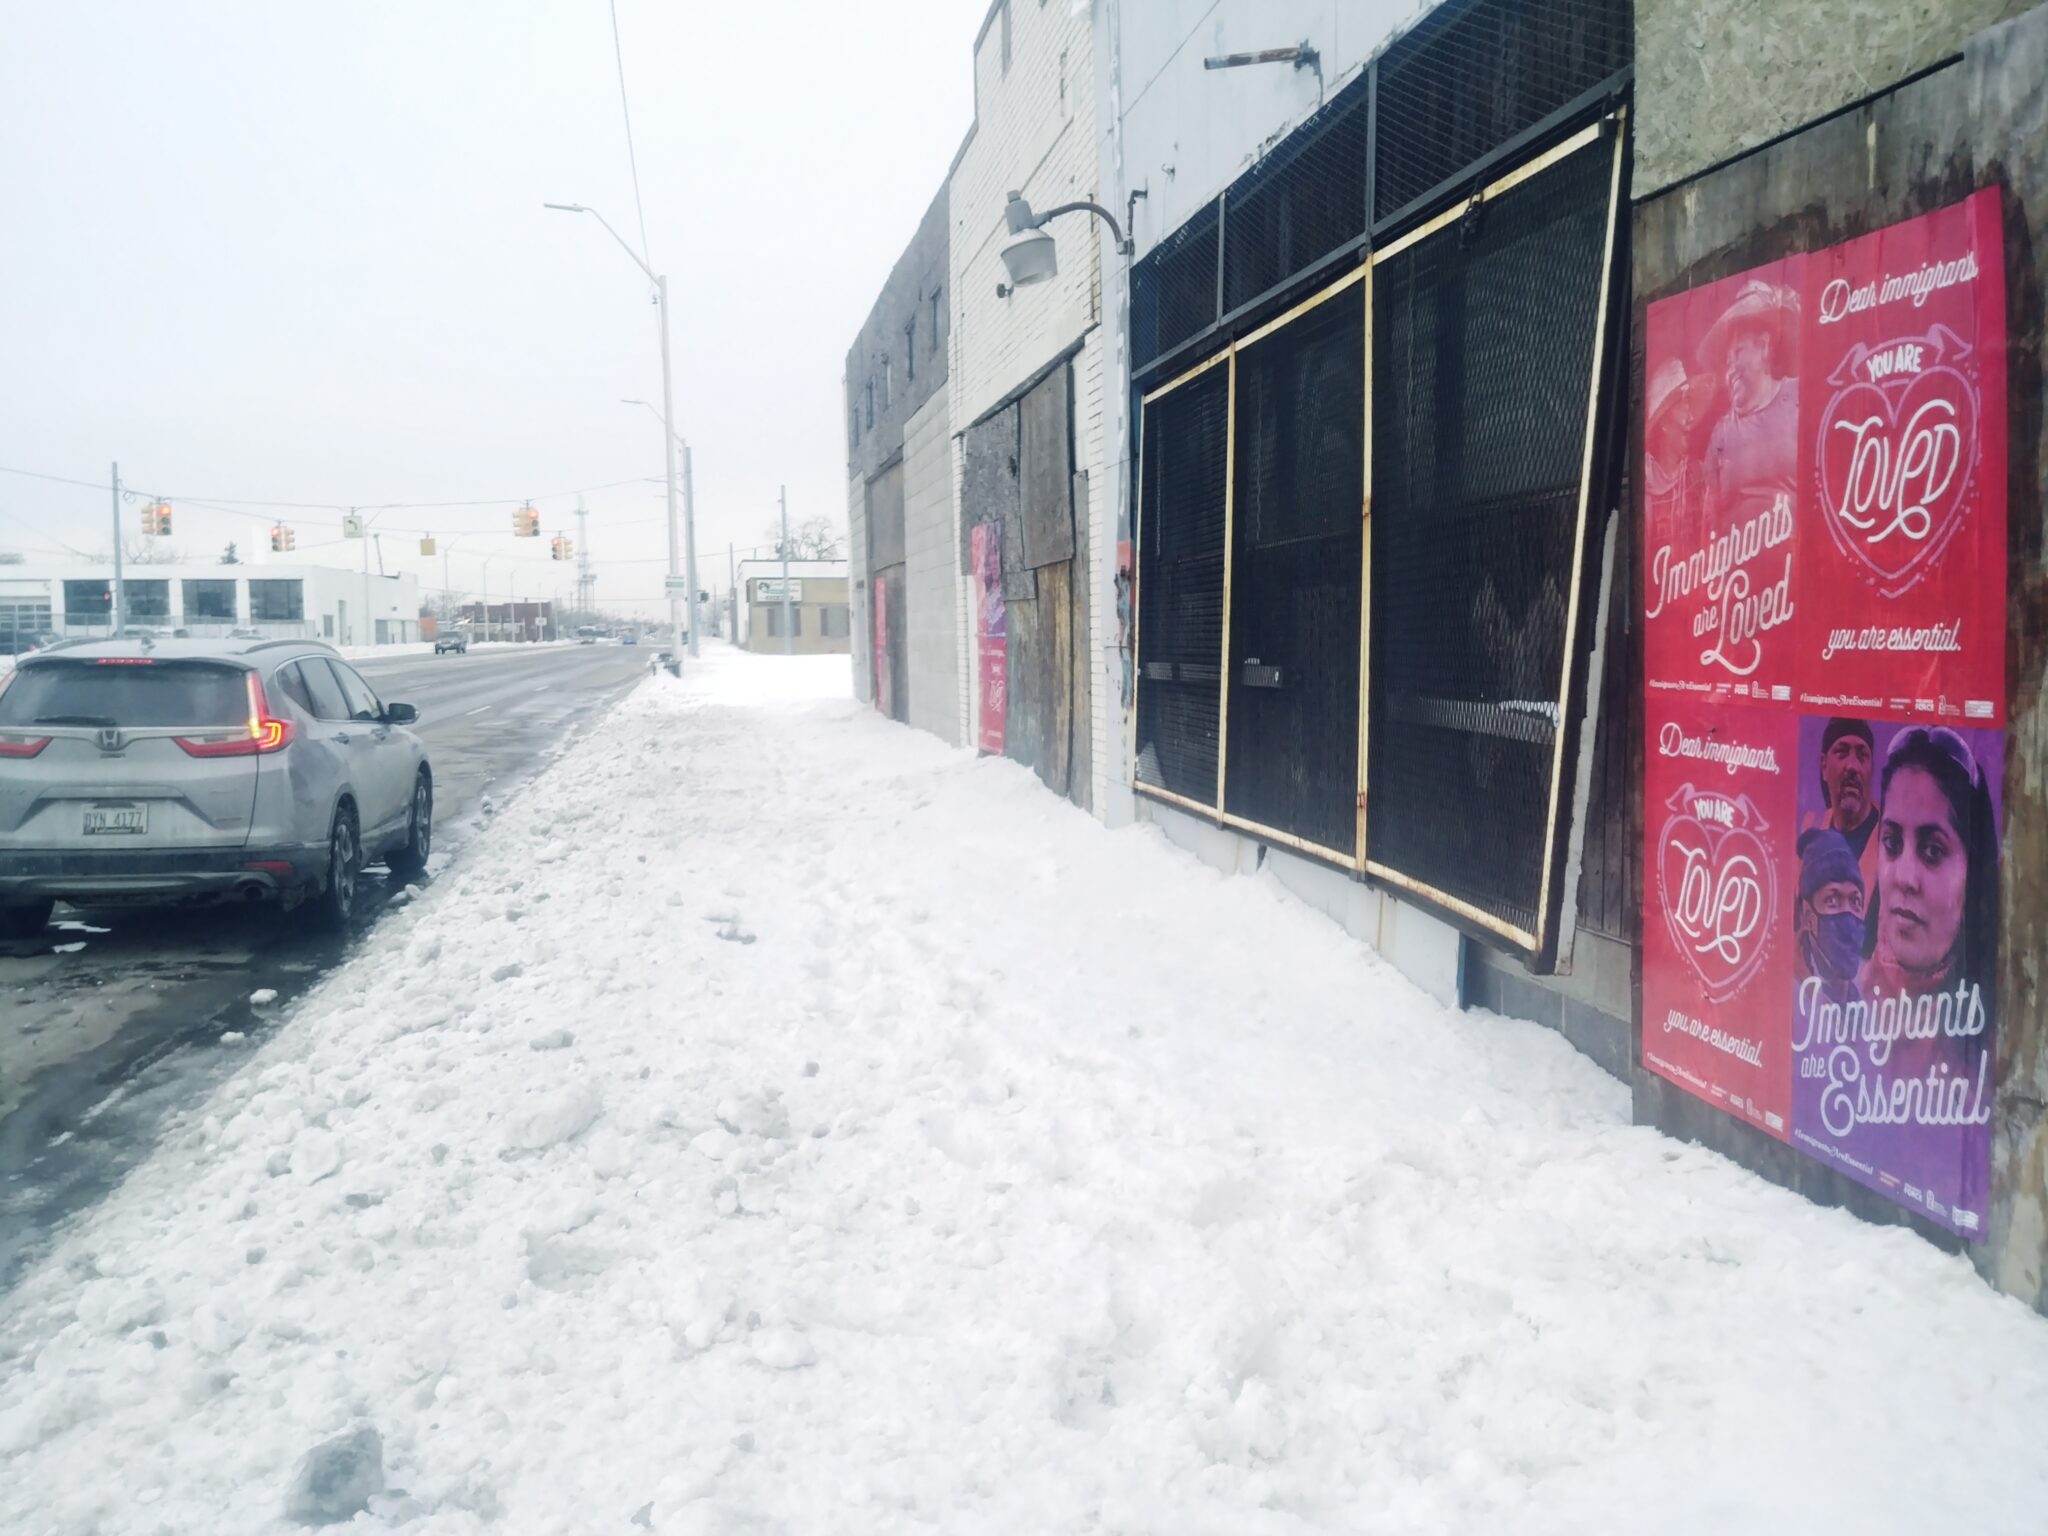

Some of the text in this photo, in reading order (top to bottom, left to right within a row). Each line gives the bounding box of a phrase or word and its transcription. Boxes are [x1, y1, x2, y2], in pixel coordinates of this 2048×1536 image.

[1819, 278, 1877, 325] Dear
[1866, 343, 1924, 383] YOU ARE
[1645, 492, 1793, 620] Immigrants
[1693, 552, 1795, 676] are Loved
[1822, 617, 1962, 660] you are essential.
[1659, 722, 1780, 775] Dear immigrants,
[1694, 798, 1735, 829] YOU ARE
[1663, 1009, 1763, 1068] you are essential.
[1791, 976, 1985, 1066] Immigrants
[1800, 1045, 1990, 1137] are Essential
